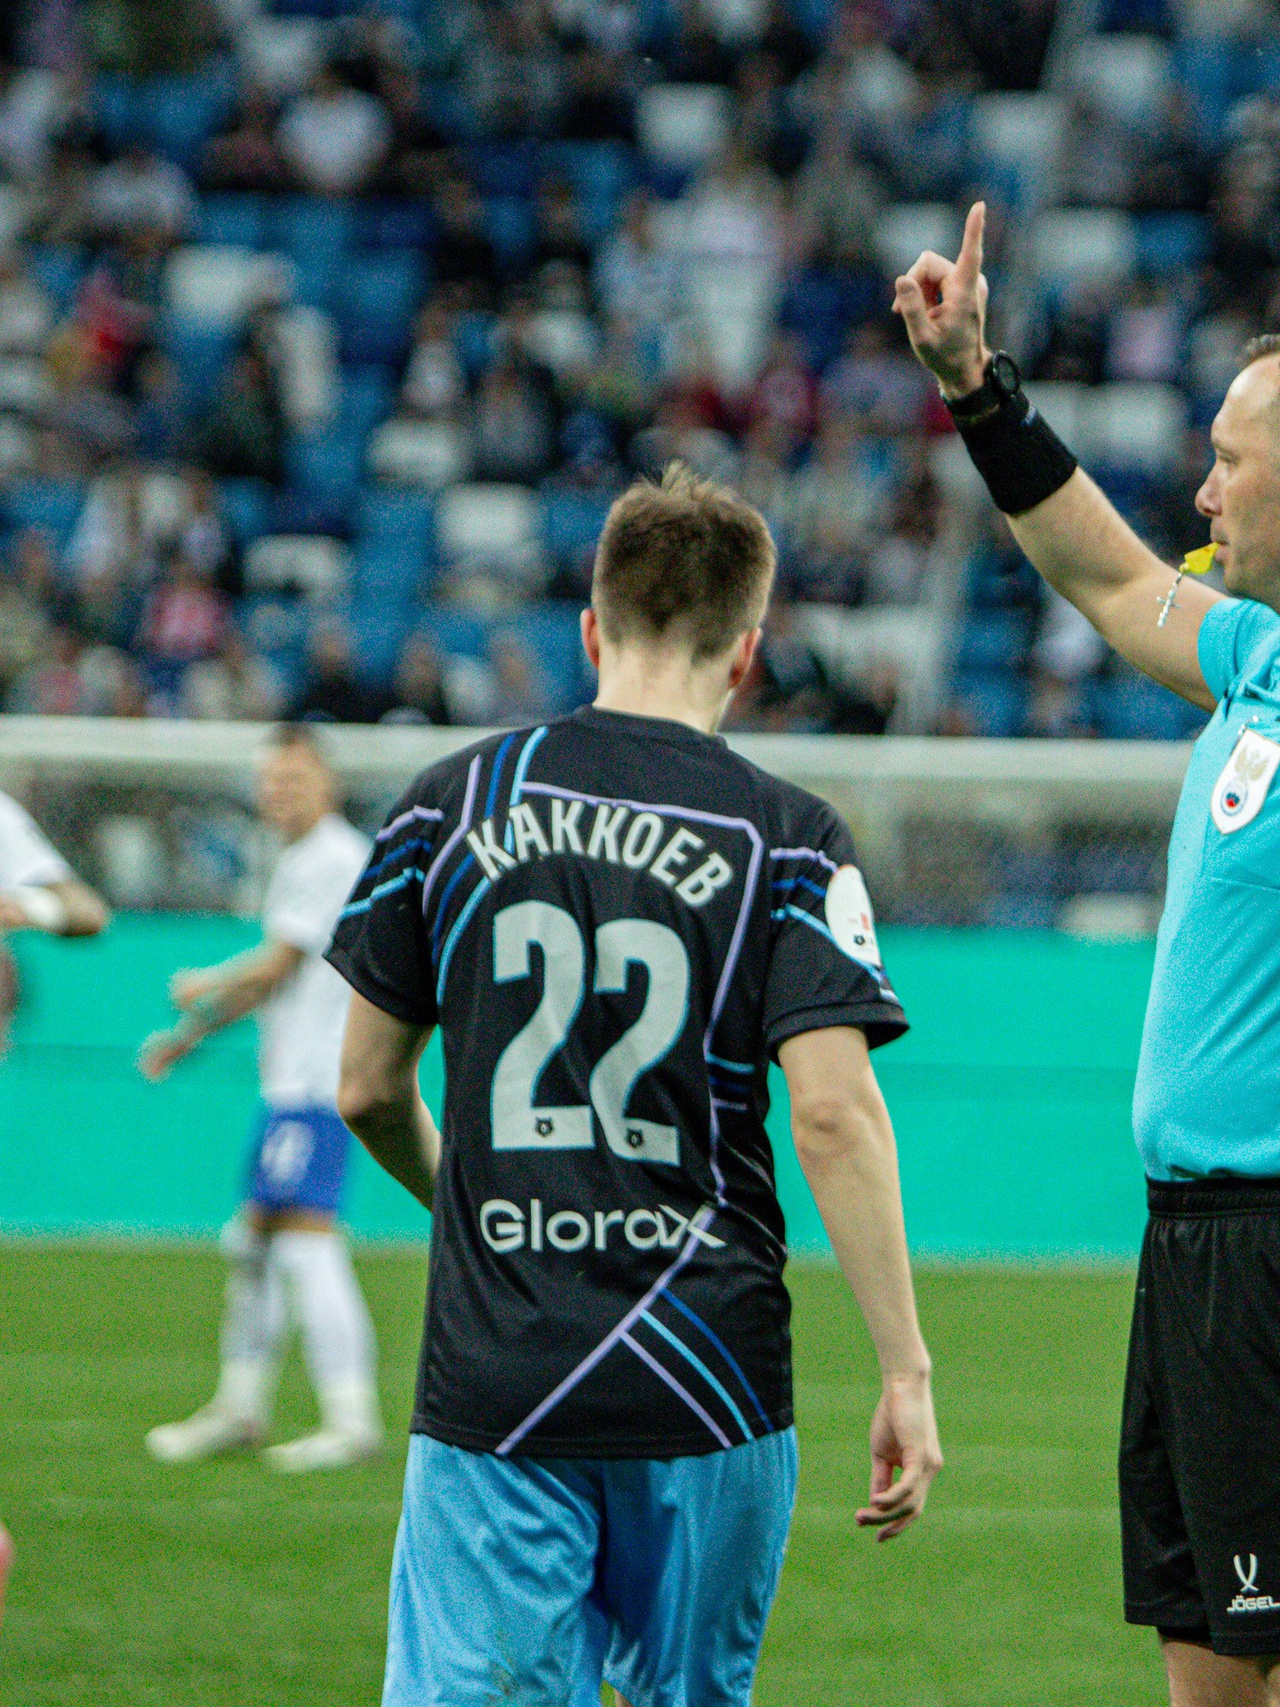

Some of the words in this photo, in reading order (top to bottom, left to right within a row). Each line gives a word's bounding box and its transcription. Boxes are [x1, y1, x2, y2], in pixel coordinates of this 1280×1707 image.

[466, 799, 734, 907] КАККОЕВ
[490, 899, 690, 1167] 22
[479, 1198, 727, 1252] Glorax
